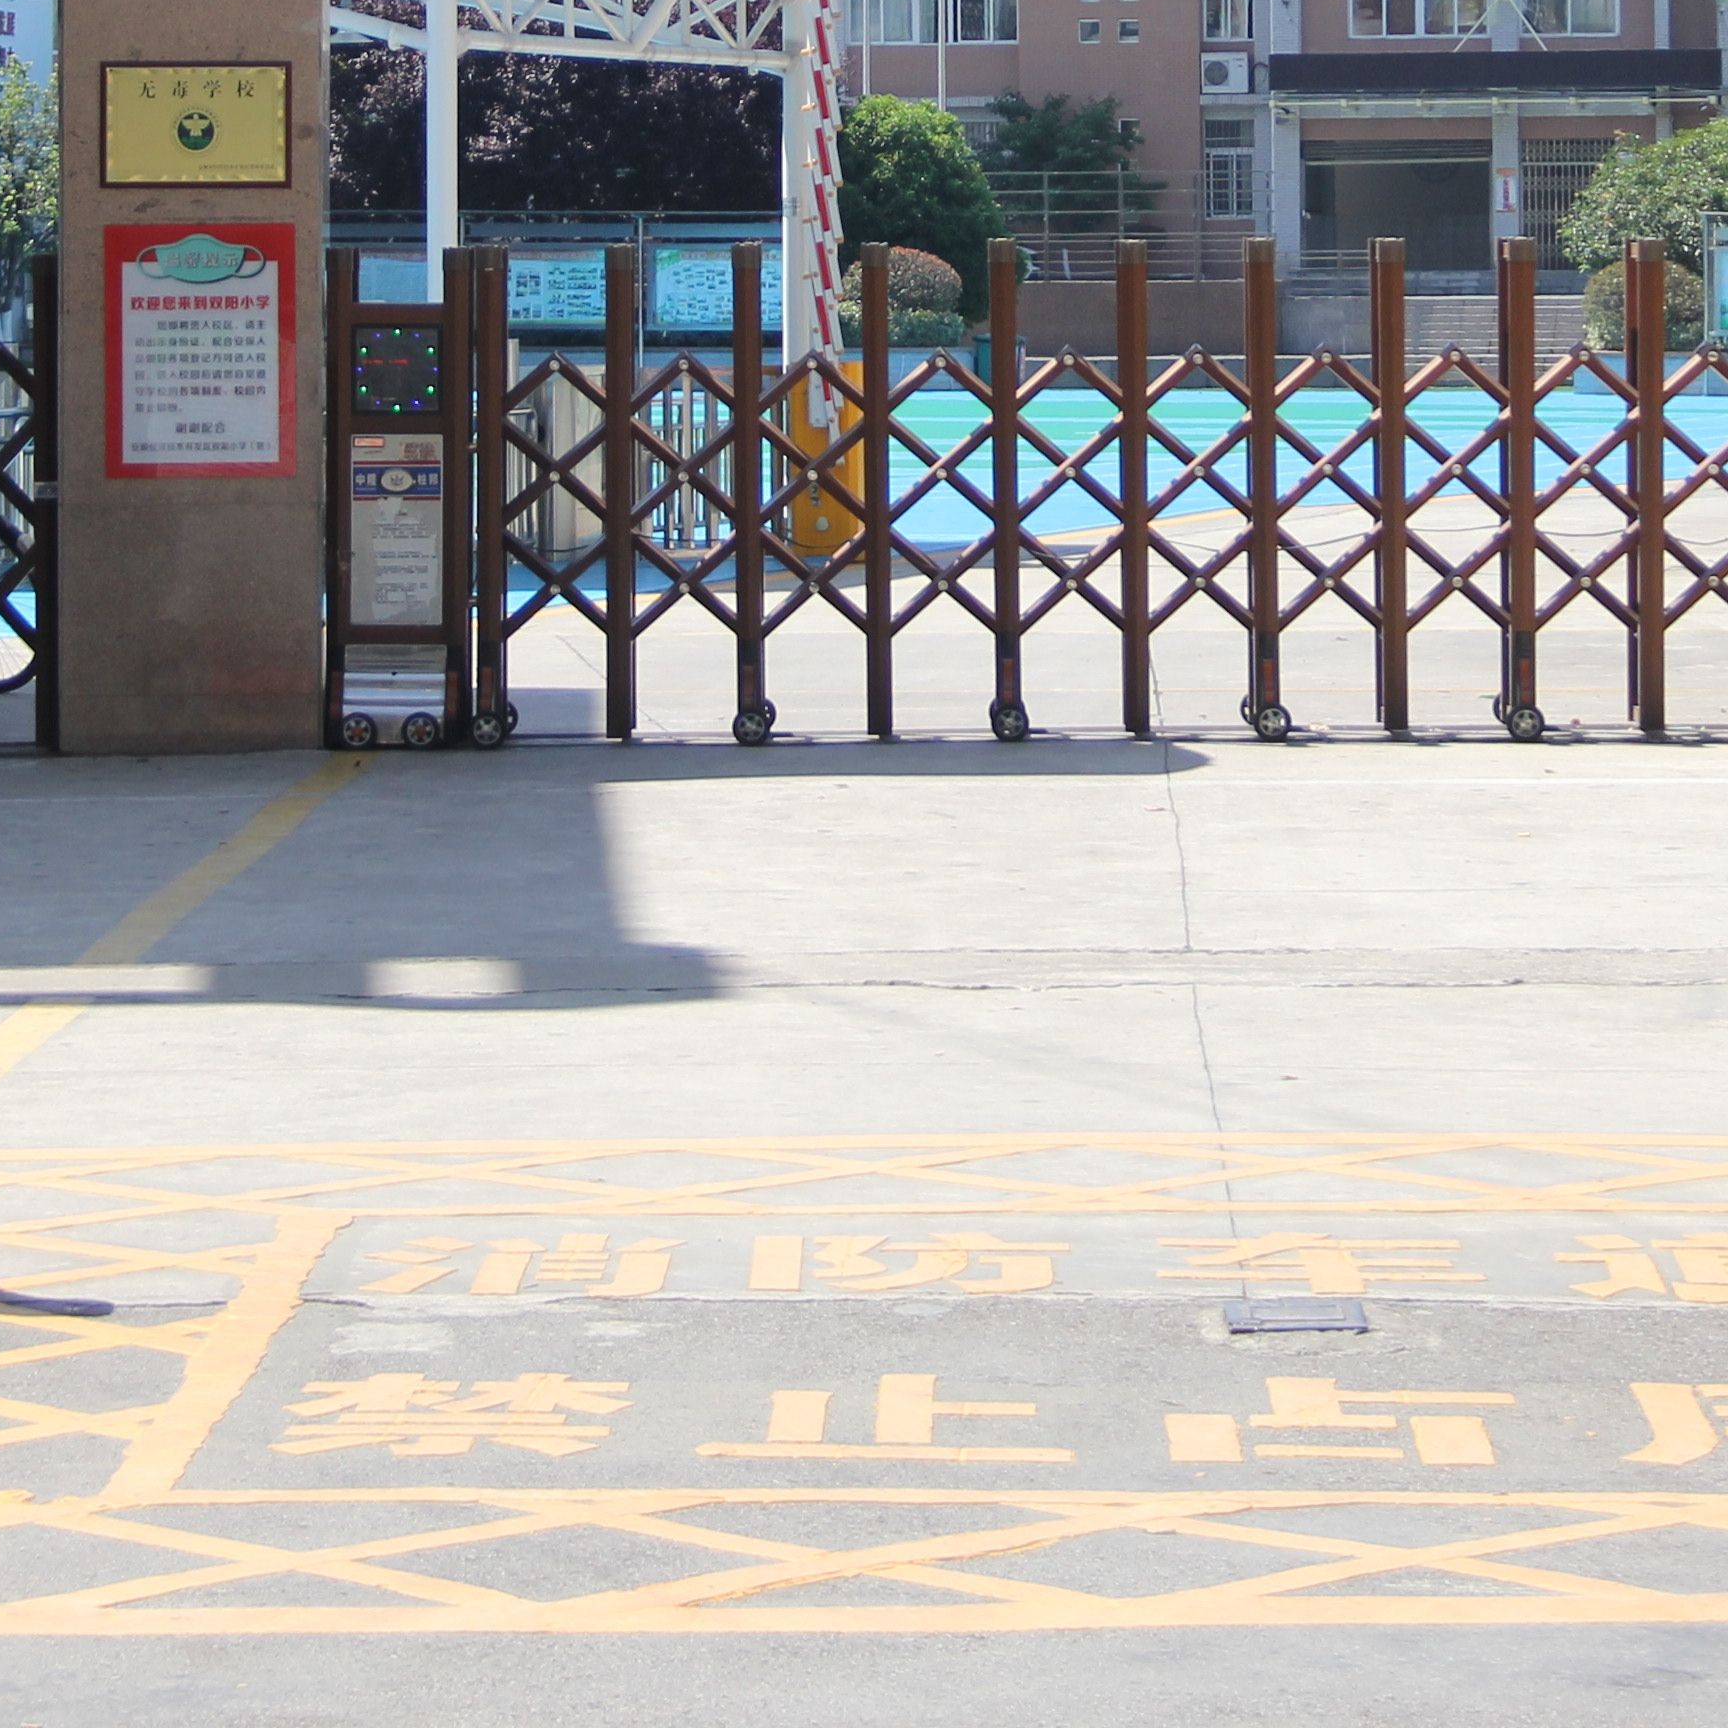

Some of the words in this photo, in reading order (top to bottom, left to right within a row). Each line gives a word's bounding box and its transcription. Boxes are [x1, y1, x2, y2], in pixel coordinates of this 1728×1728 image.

[138, 79, 256, 100] 无毒学校
[130, 295, 271, 311] 欢迎您来到双阳小学
